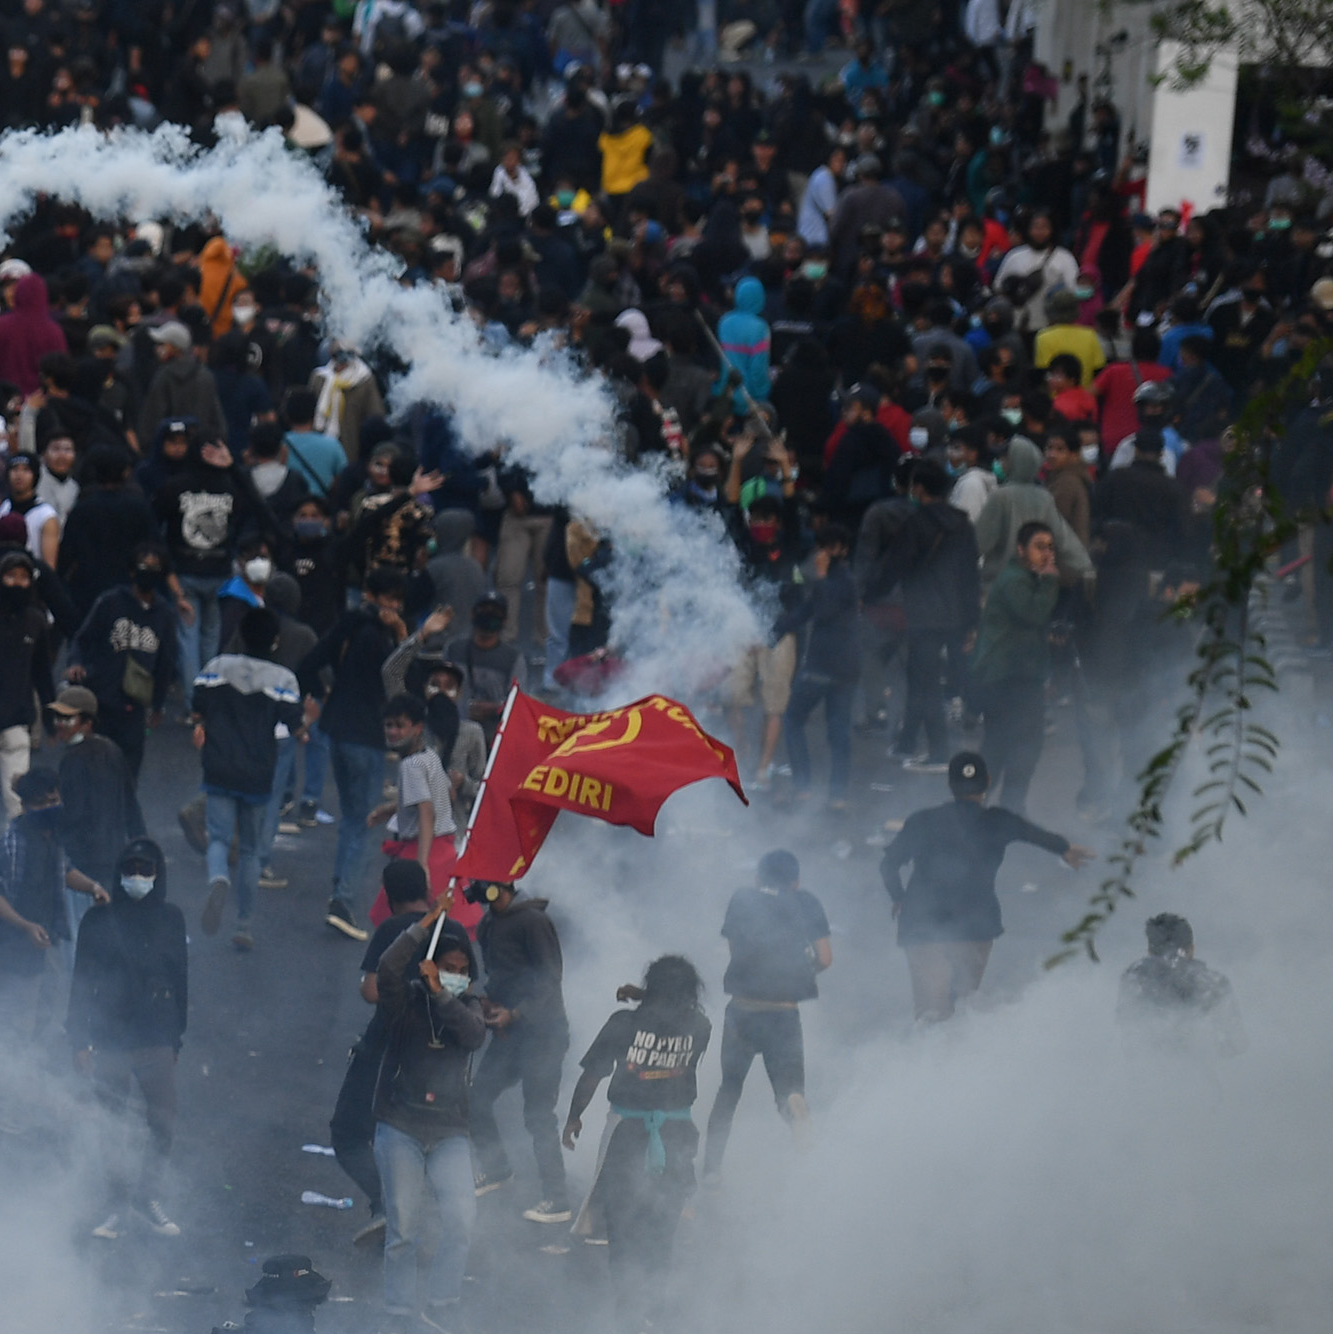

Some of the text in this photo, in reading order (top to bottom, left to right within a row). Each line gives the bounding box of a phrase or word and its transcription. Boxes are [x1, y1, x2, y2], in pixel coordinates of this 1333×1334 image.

[519, 765, 613, 812] EDIRI
[634, 1031, 656, 1049] NO
[627, 1046, 648, 1065] NO
